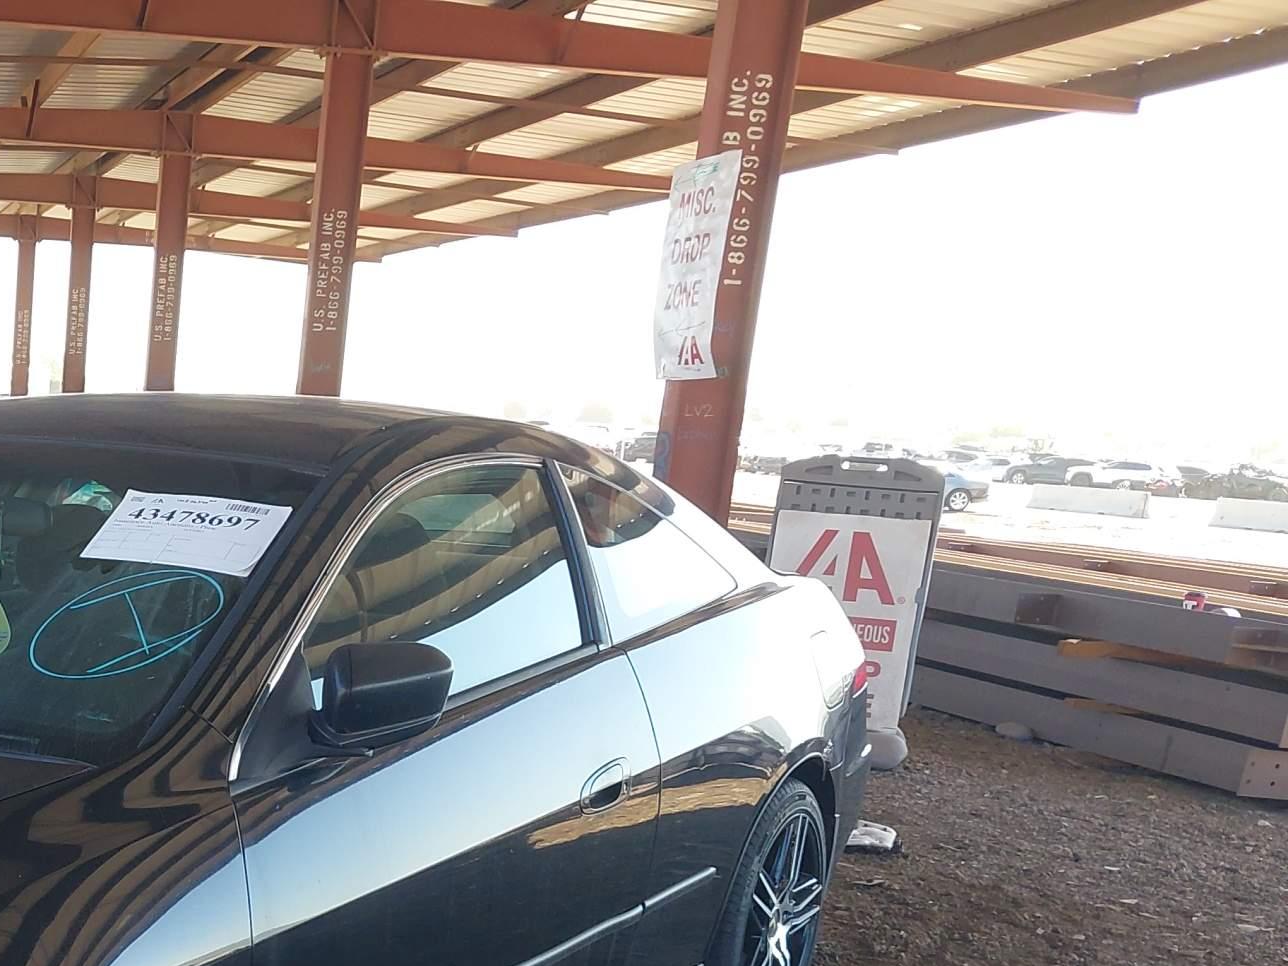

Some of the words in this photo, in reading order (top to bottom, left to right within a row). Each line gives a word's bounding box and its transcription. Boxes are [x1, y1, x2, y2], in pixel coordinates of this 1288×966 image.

[727, 69, 751, 118] INC.
[723, 73, 775, 286] 1-866-799-0969
[679, 186, 716, 219] MISC.
[322, 208, 335, 235] INC.
[671, 233, 710, 264] DROP
[316, 242, 332, 297] PREFAB
[325, 210, 348, 331] 1-866-799-0969
[664, 279, 702, 311] ZONE
[312, 305, 326, 332] U.S.
[127, 507, 261, 531] 43478697
